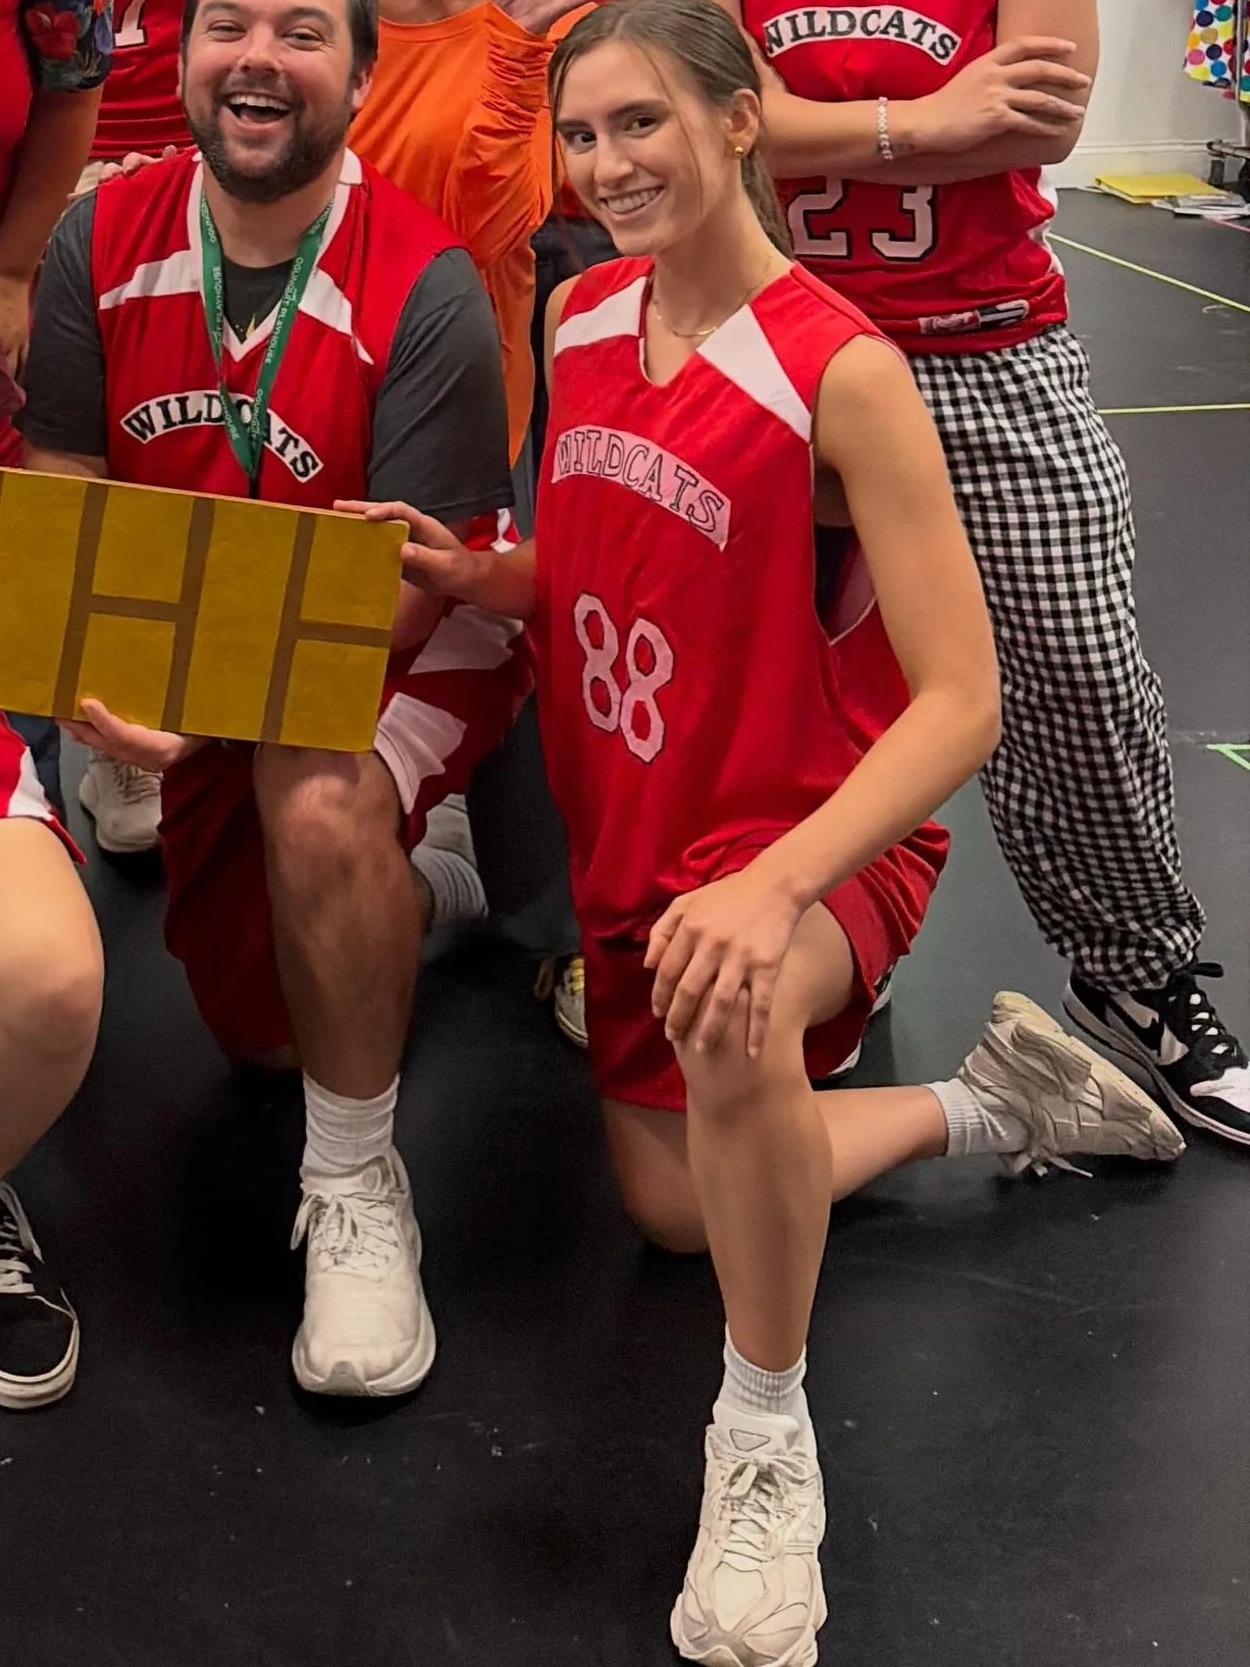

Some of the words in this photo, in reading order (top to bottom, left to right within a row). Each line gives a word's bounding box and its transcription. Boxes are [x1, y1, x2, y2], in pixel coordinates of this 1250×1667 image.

[764, 9, 958, 60] WILDCATS
[786, 175, 938, 262] 23
[557, 430, 725, 533] WILDCATS
[573, 590, 675, 765] 88
